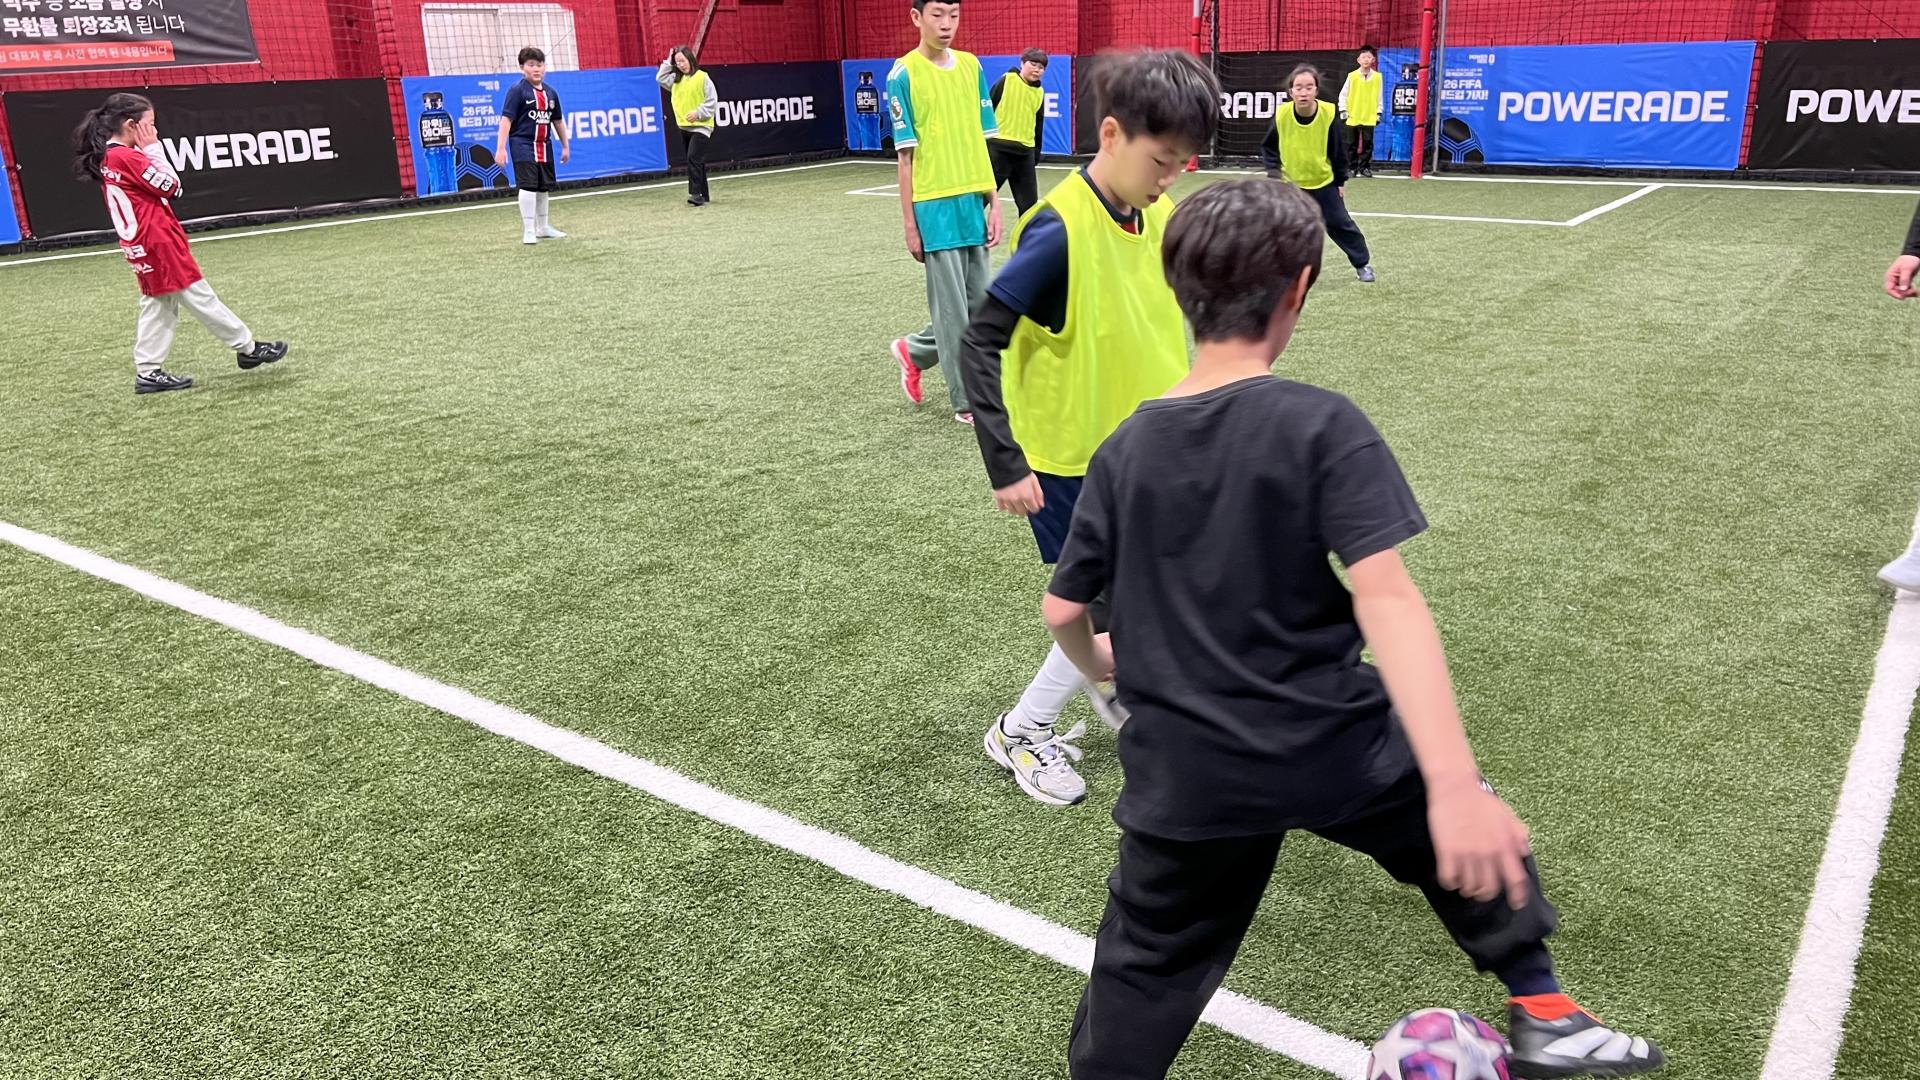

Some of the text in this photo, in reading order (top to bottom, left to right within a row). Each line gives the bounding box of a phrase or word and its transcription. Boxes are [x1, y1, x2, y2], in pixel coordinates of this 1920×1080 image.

[2, 14, 185, 38] 무환불 퇴장조치 됩니다
[120, 45, 168, 58] 내용입니다
[1443, 79, 1482, 89] 26 FIFA
[462, 105, 495, 117] 26 FIFA
[715, 96, 815, 127] OWERADE
[1498, 90, 1729, 122] POWERADE
[162, 127, 334, 172] WERADE
